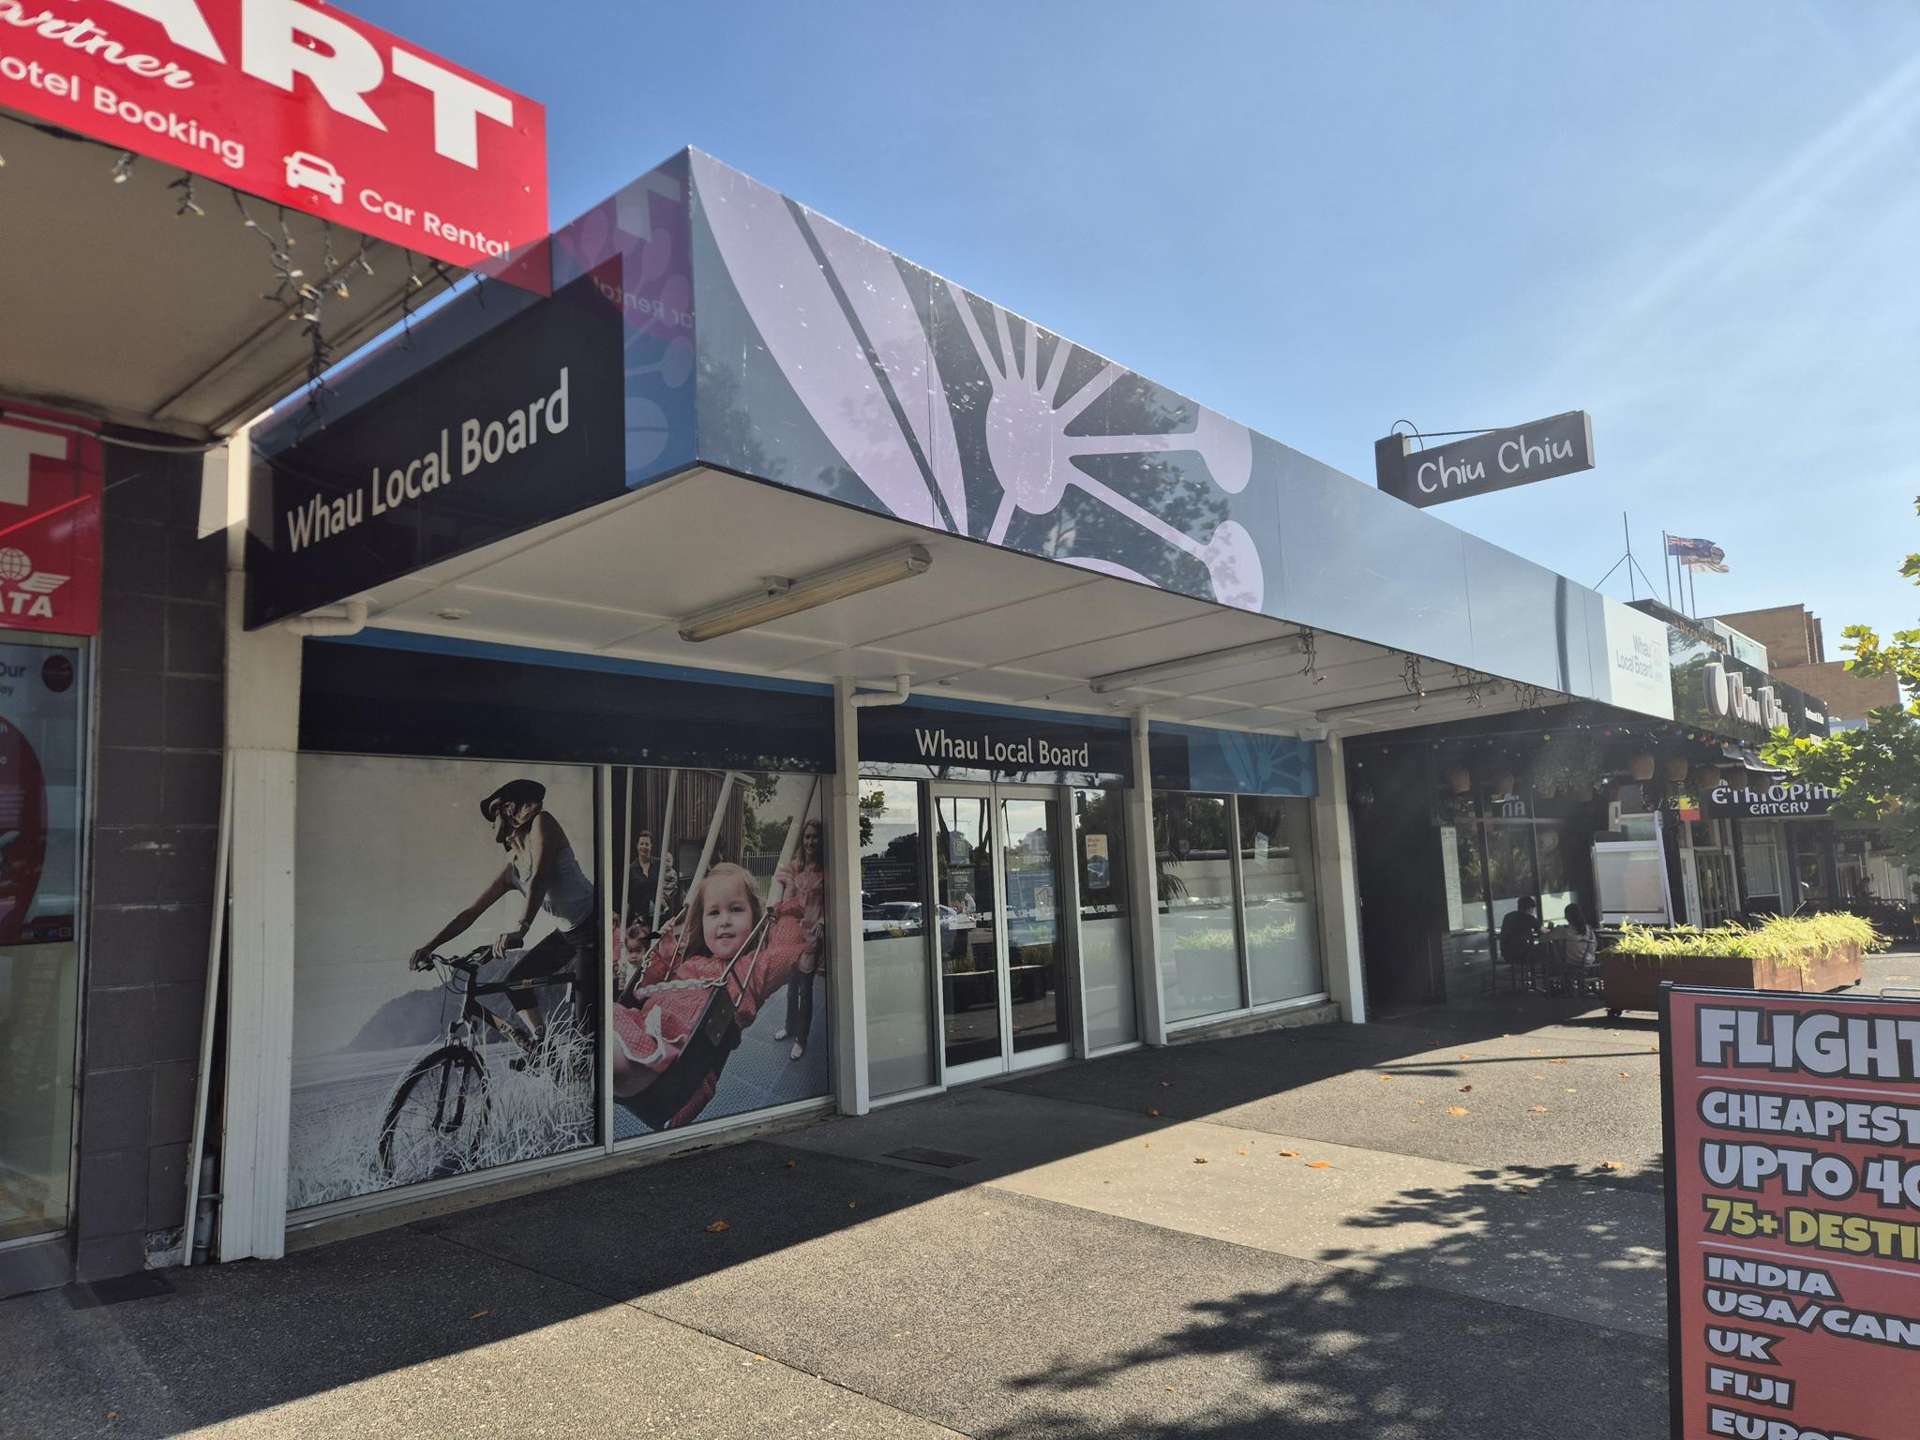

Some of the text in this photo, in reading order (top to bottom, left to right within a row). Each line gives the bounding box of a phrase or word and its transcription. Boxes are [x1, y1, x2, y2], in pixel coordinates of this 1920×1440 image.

[94, 86, 245, 169] Booking
[359, 188, 511, 261] Car Rental
[287, 366, 569, 553] Whau Local Board
[1417, 435, 1574, 493] Chiu Chiu
[915, 728, 1089, 768] Whau Local Board
[1702, 1091, 1920, 1144] CHEAPEST
[1706, 1199, 1920, 1260] 75+ DESTI
[1708, 1256, 1836, 1297] INDIA
[1708, 1328, 1771, 1360] UK
[1710, 1367, 1790, 1405] FIJI
[1712, 1408, 1852, 1440] EUR
